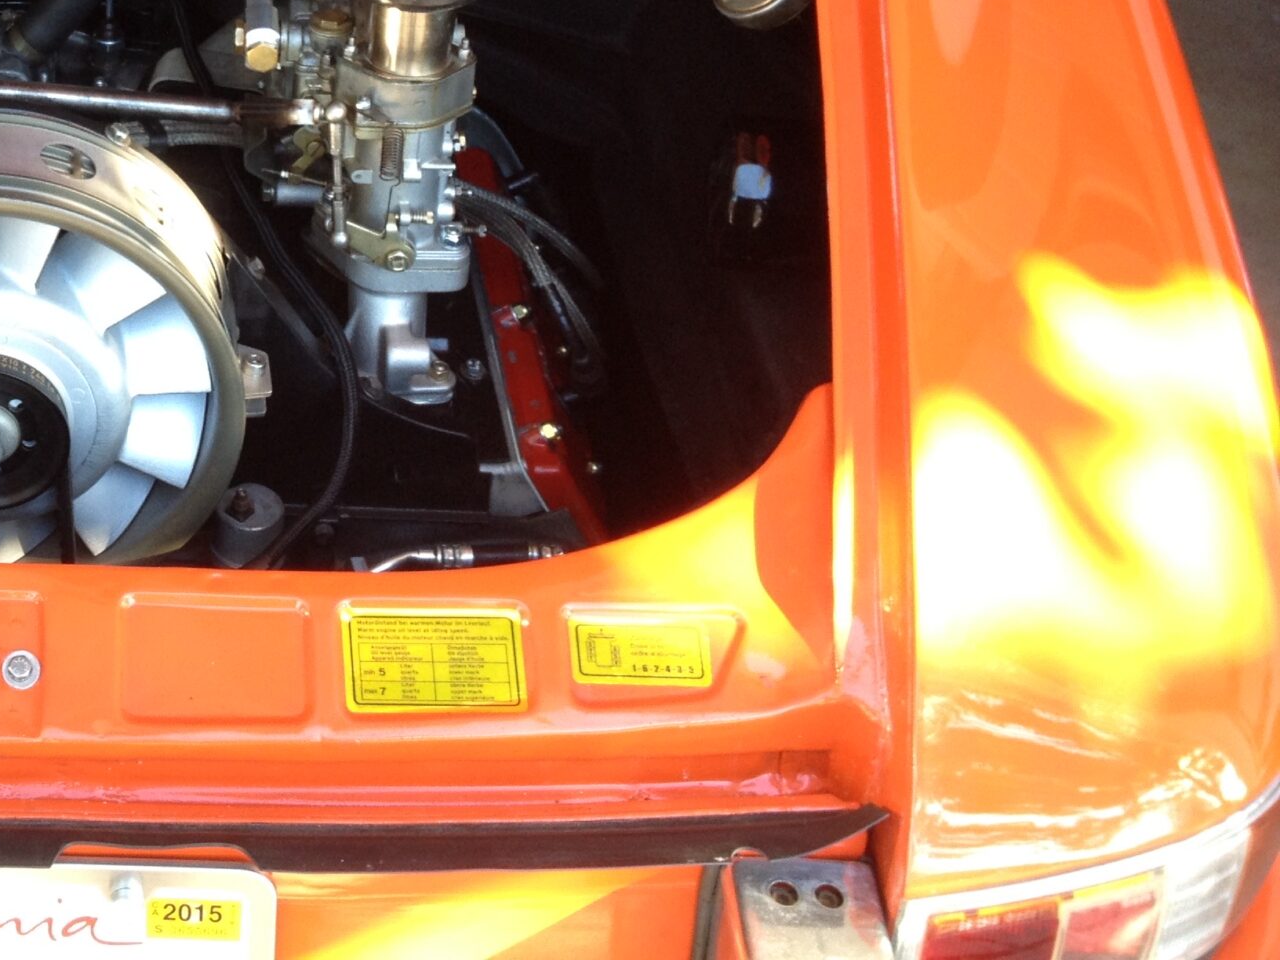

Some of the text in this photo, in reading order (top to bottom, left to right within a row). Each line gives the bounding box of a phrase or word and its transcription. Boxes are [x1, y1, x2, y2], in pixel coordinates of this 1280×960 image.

[379, 667, 386, 676] 5
[379, 687, 386, 696] 7
[163, 903, 223, 923] 2015
